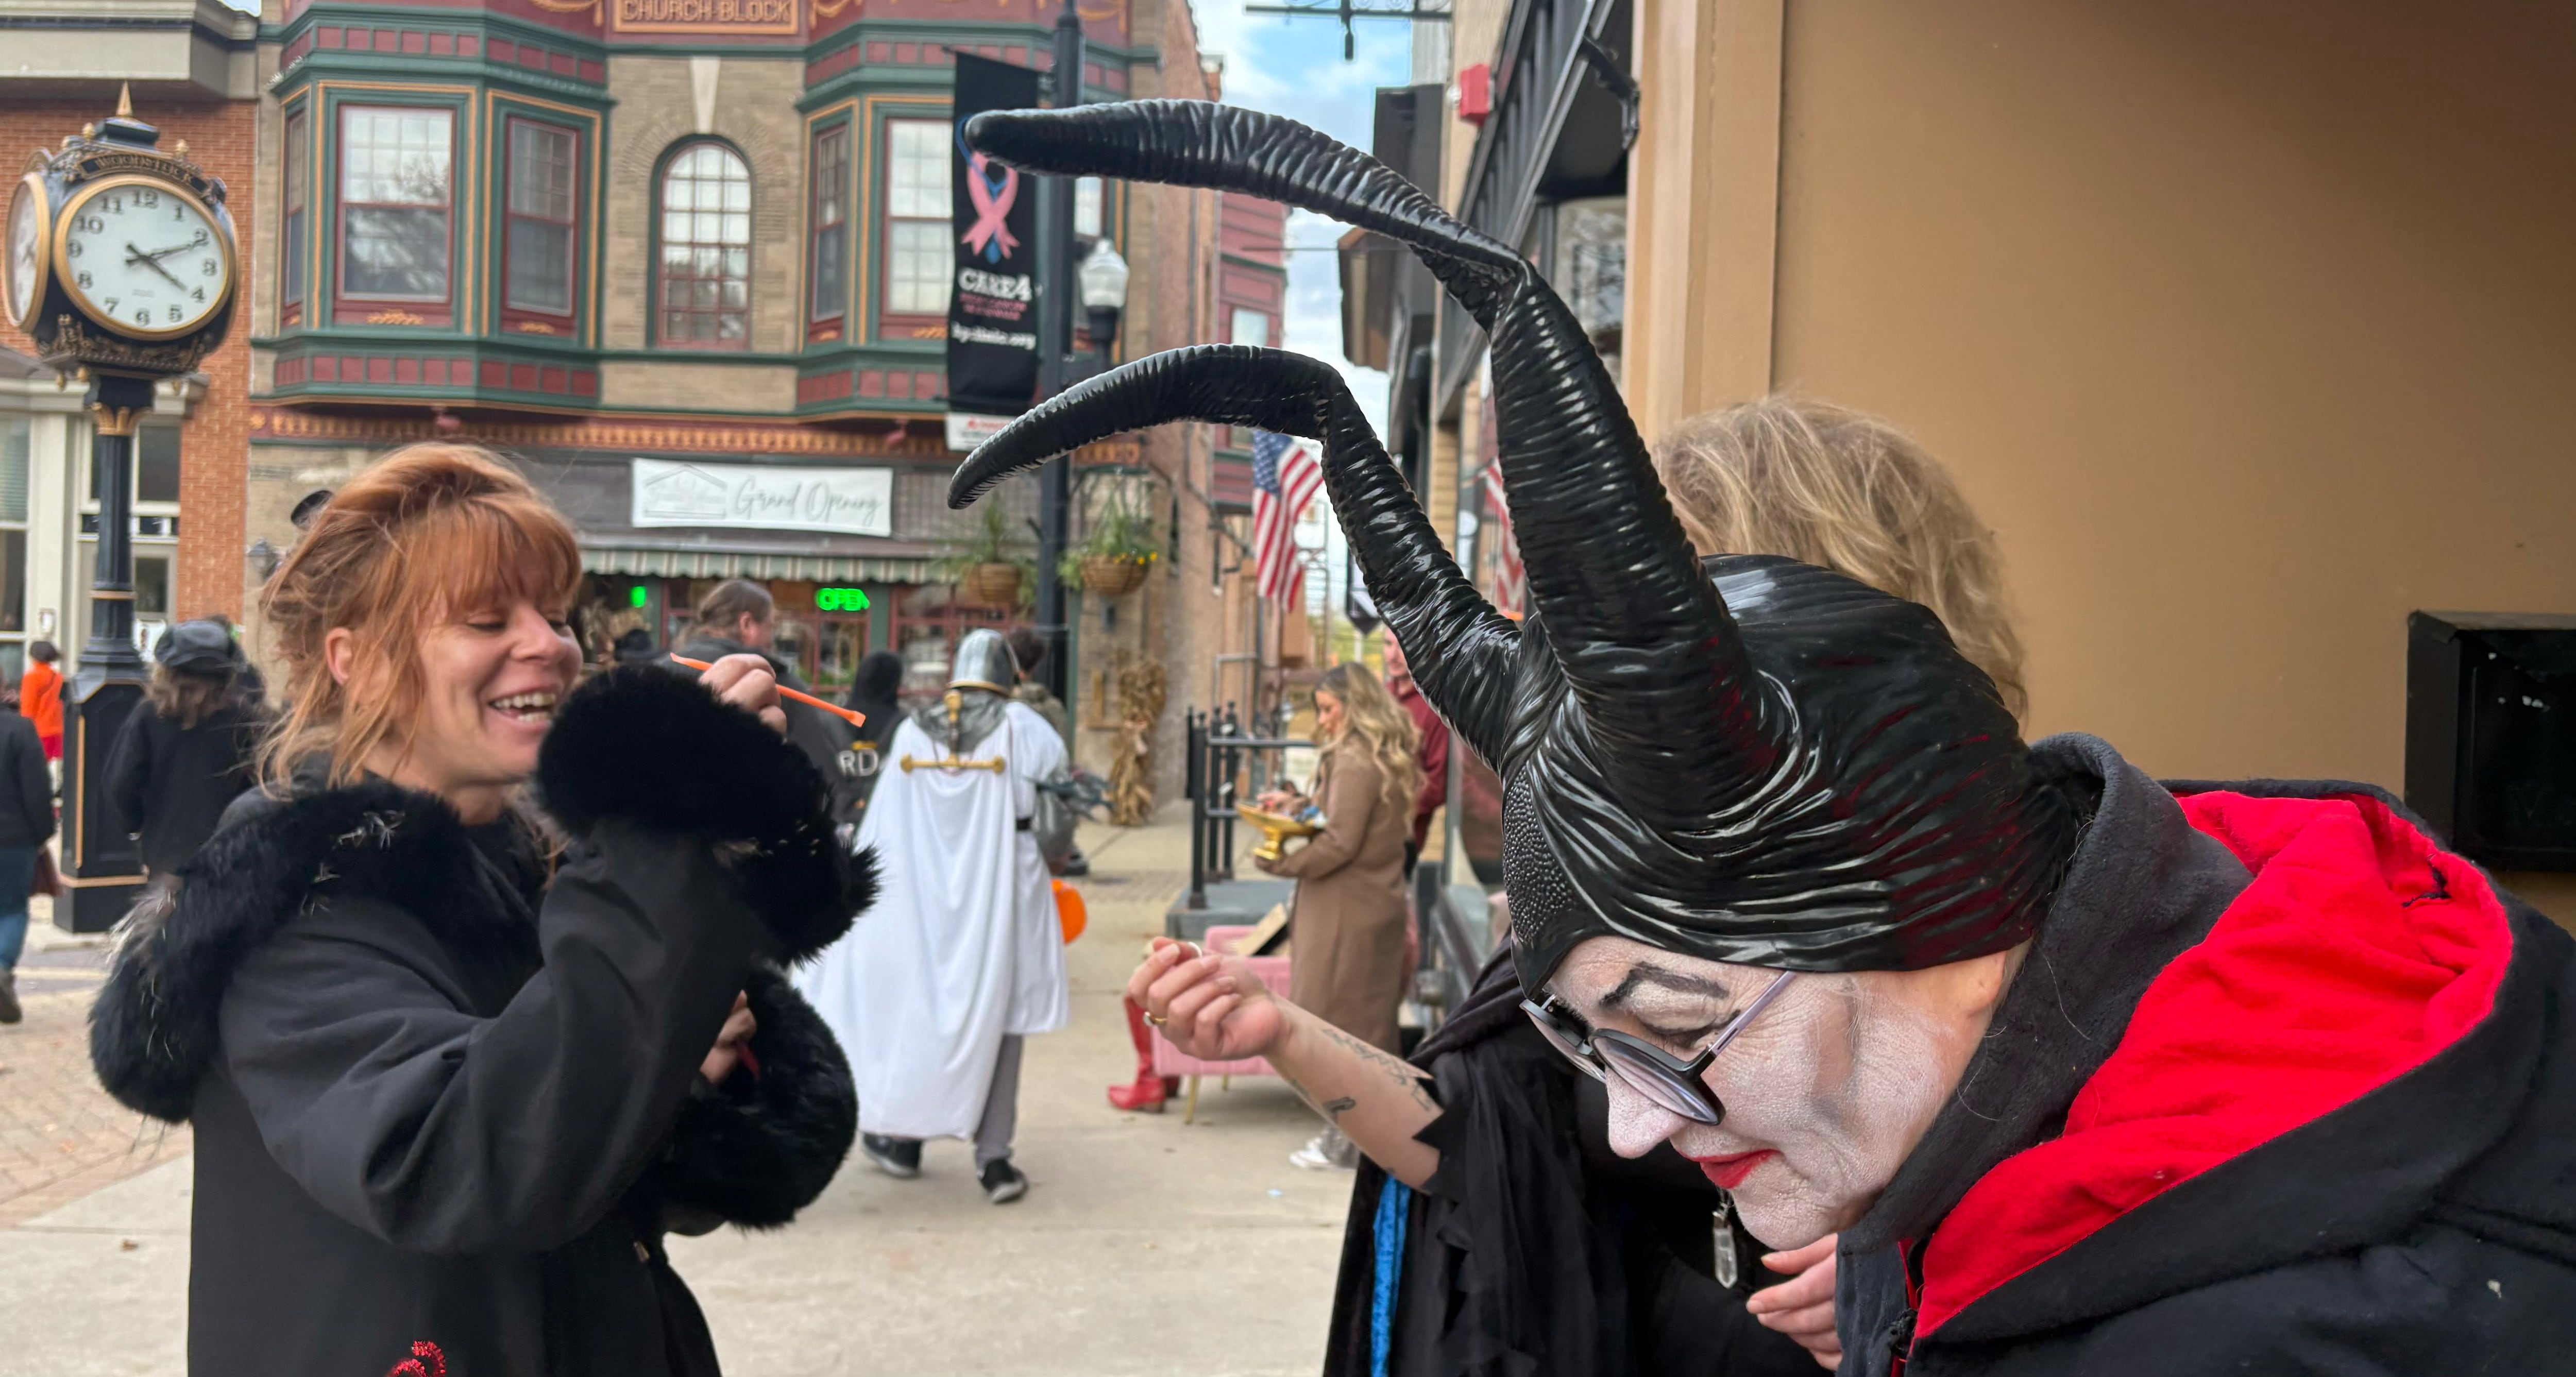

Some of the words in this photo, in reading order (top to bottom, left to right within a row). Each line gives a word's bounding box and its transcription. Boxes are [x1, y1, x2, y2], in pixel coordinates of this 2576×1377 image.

[621, 0, 712, 21] CHURCH
[719, 0, 790, 22] BLOCK
[101, 195, 123, 214] 11
[132, 190, 159, 209] 12
[174, 205, 184, 222] 1
[77, 215, 104, 234] 10
[194, 228, 209, 245] 2
[68, 239, 83, 258] 9
[202, 258, 217, 277] 3
[78, 269, 93, 288] 8
[191, 285, 206, 303] 4
[104, 296, 120, 315] 7
[168, 304, 183, 323] 5
[135, 308, 151, 327] 6
[736, 473, 802, 520] Grand
[805, 480, 882, 528] Opening
